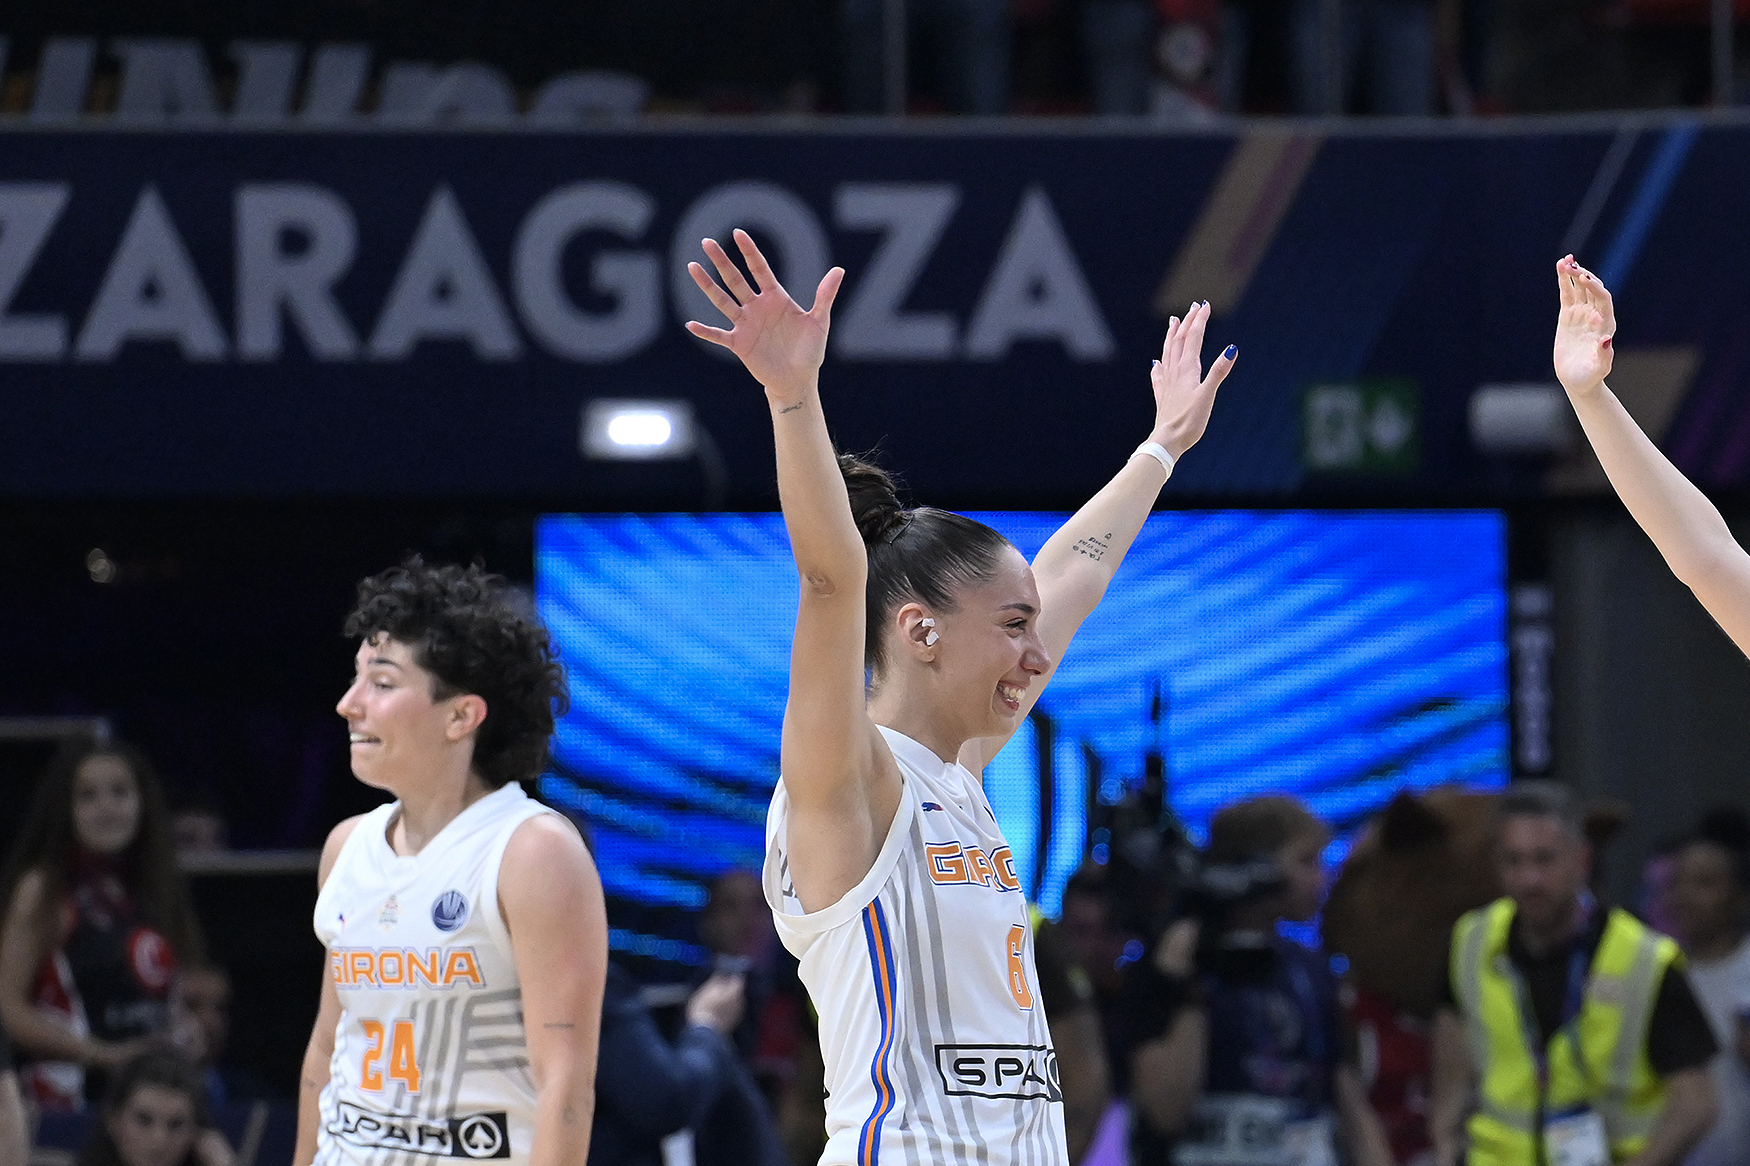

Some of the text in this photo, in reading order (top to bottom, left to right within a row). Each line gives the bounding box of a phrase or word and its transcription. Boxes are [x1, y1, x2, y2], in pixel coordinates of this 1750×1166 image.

[1006, 924, 1034, 1011] 6
[358, 1017, 420, 1095] 24
[953, 1056, 1046, 1088] SPA
